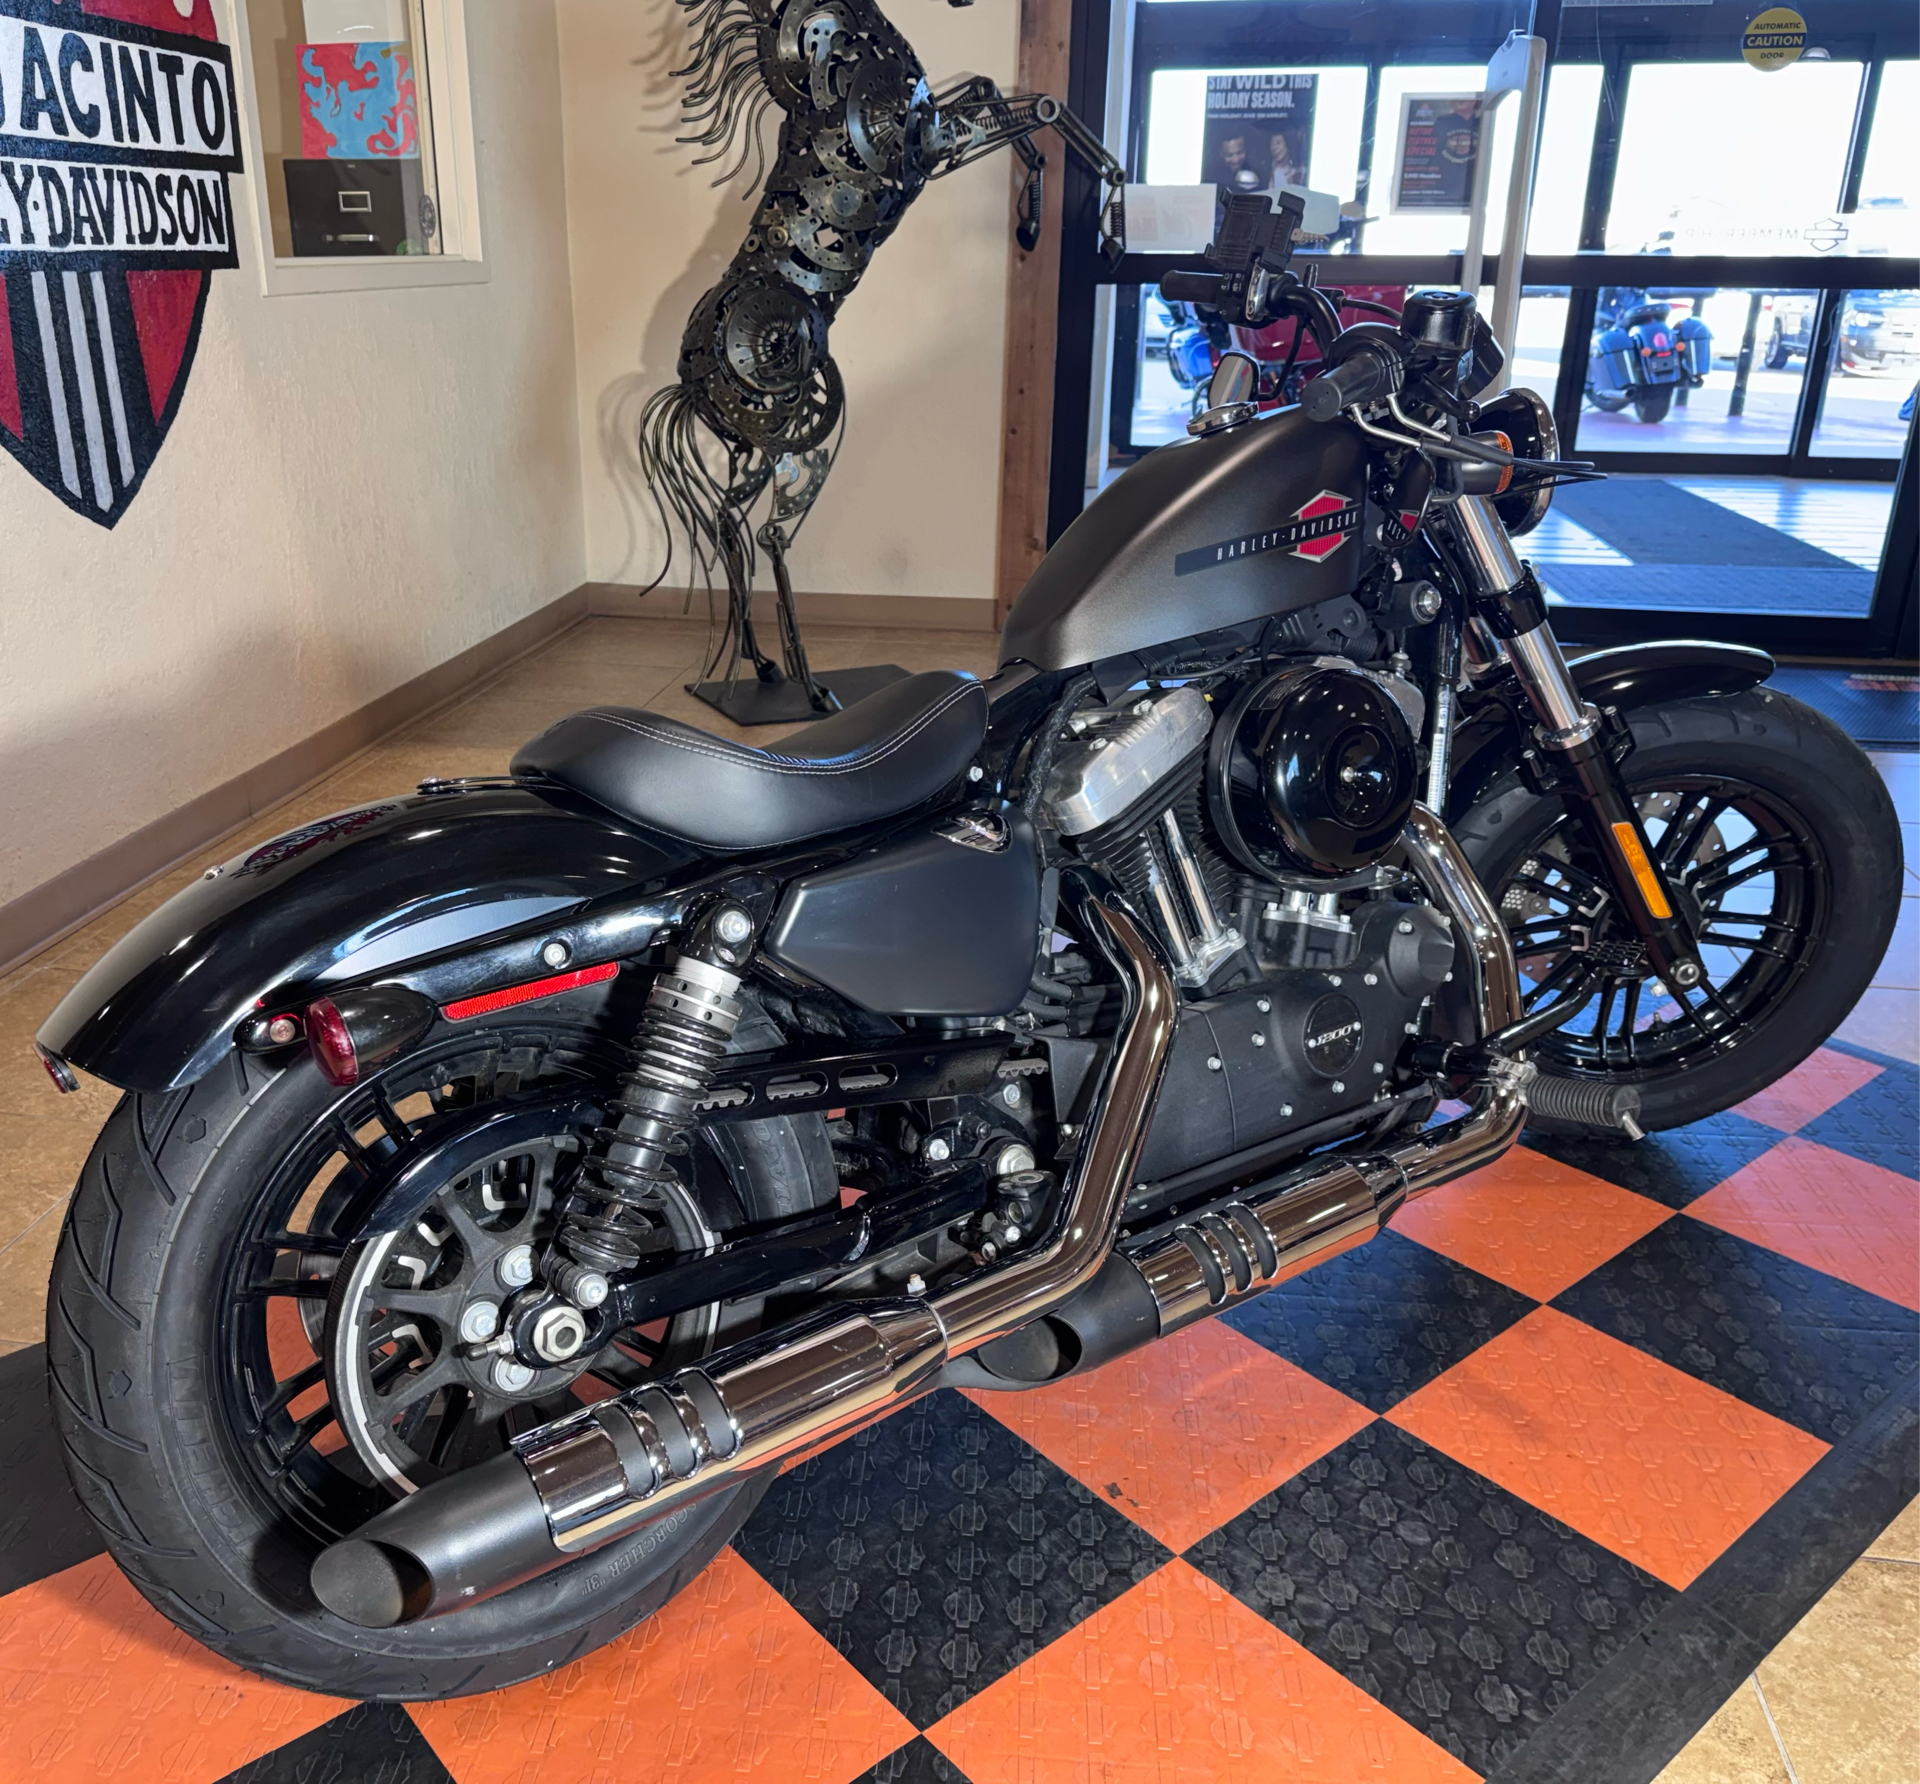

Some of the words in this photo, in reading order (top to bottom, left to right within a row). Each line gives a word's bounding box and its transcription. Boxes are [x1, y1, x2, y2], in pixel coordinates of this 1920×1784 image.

[1754, 22, 1802, 30] AUTOMATIC
[1747, 35, 1803, 47] CAUTION
[0, 26, 226, 151] ACINTO
[1208, 75, 1233, 90] STAY
[1235, 74, 1287, 90] WILD
[1288, 74, 1313, 89] THIS
[1207, 91, 1251, 109] HOLIDAY
[1250, 91, 1295, 109] SEASON.
[1316, 1025, 1352, 1047] 1200
[168, 1359, 262, 1556] ICHELIN
[607, 1501, 697, 1579] SCORCHER
